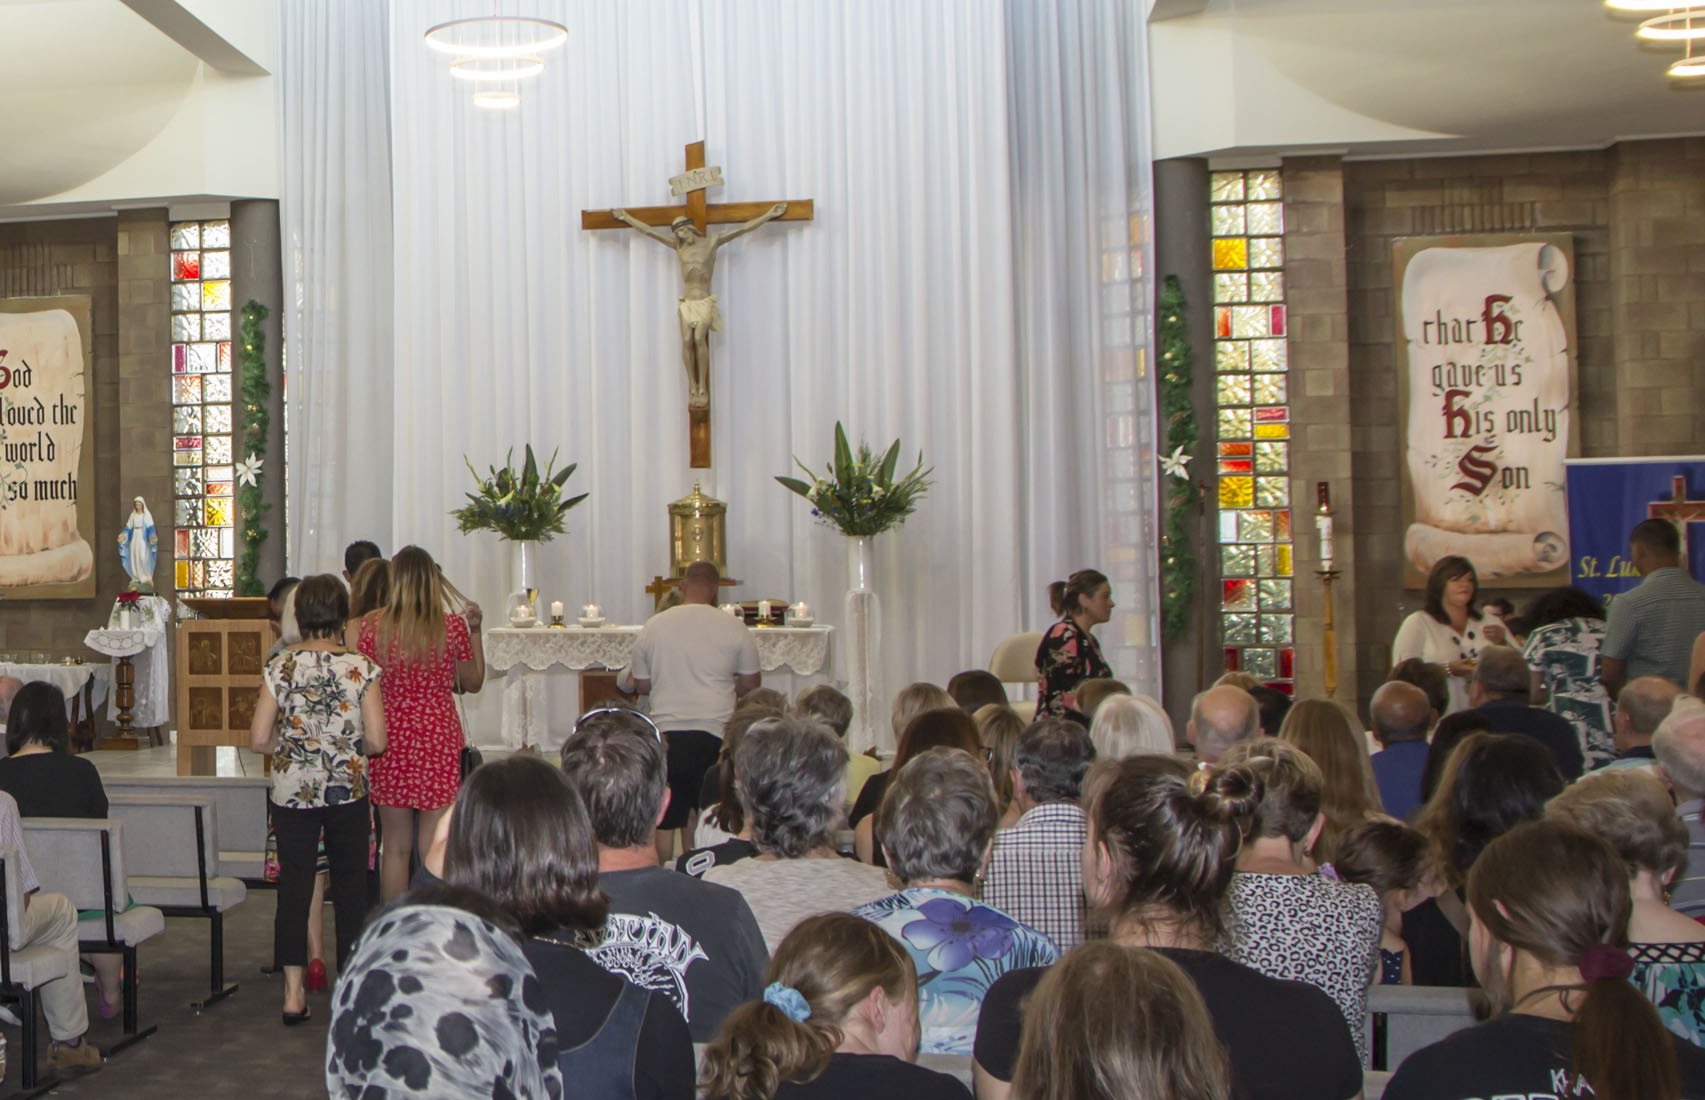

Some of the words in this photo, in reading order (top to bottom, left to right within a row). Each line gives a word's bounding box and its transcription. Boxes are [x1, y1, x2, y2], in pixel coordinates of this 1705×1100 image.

[1423, 309, 1477, 345] that
[1481, 294, 1524, 345] He
[1432, 361, 1487, 397] gave
[1495, 362, 1522, 386] us
[53, 394, 77, 425] the
[1442, 389, 1495, 439] His
[1506, 398, 1556, 442] only
[4, 432, 55, 463] world
[1450, 444, 1531, 496] Son
[8, 480, 28, 502] so
[34, 472, 77, 502] much
[1577, 555, 1601, 578] St.
